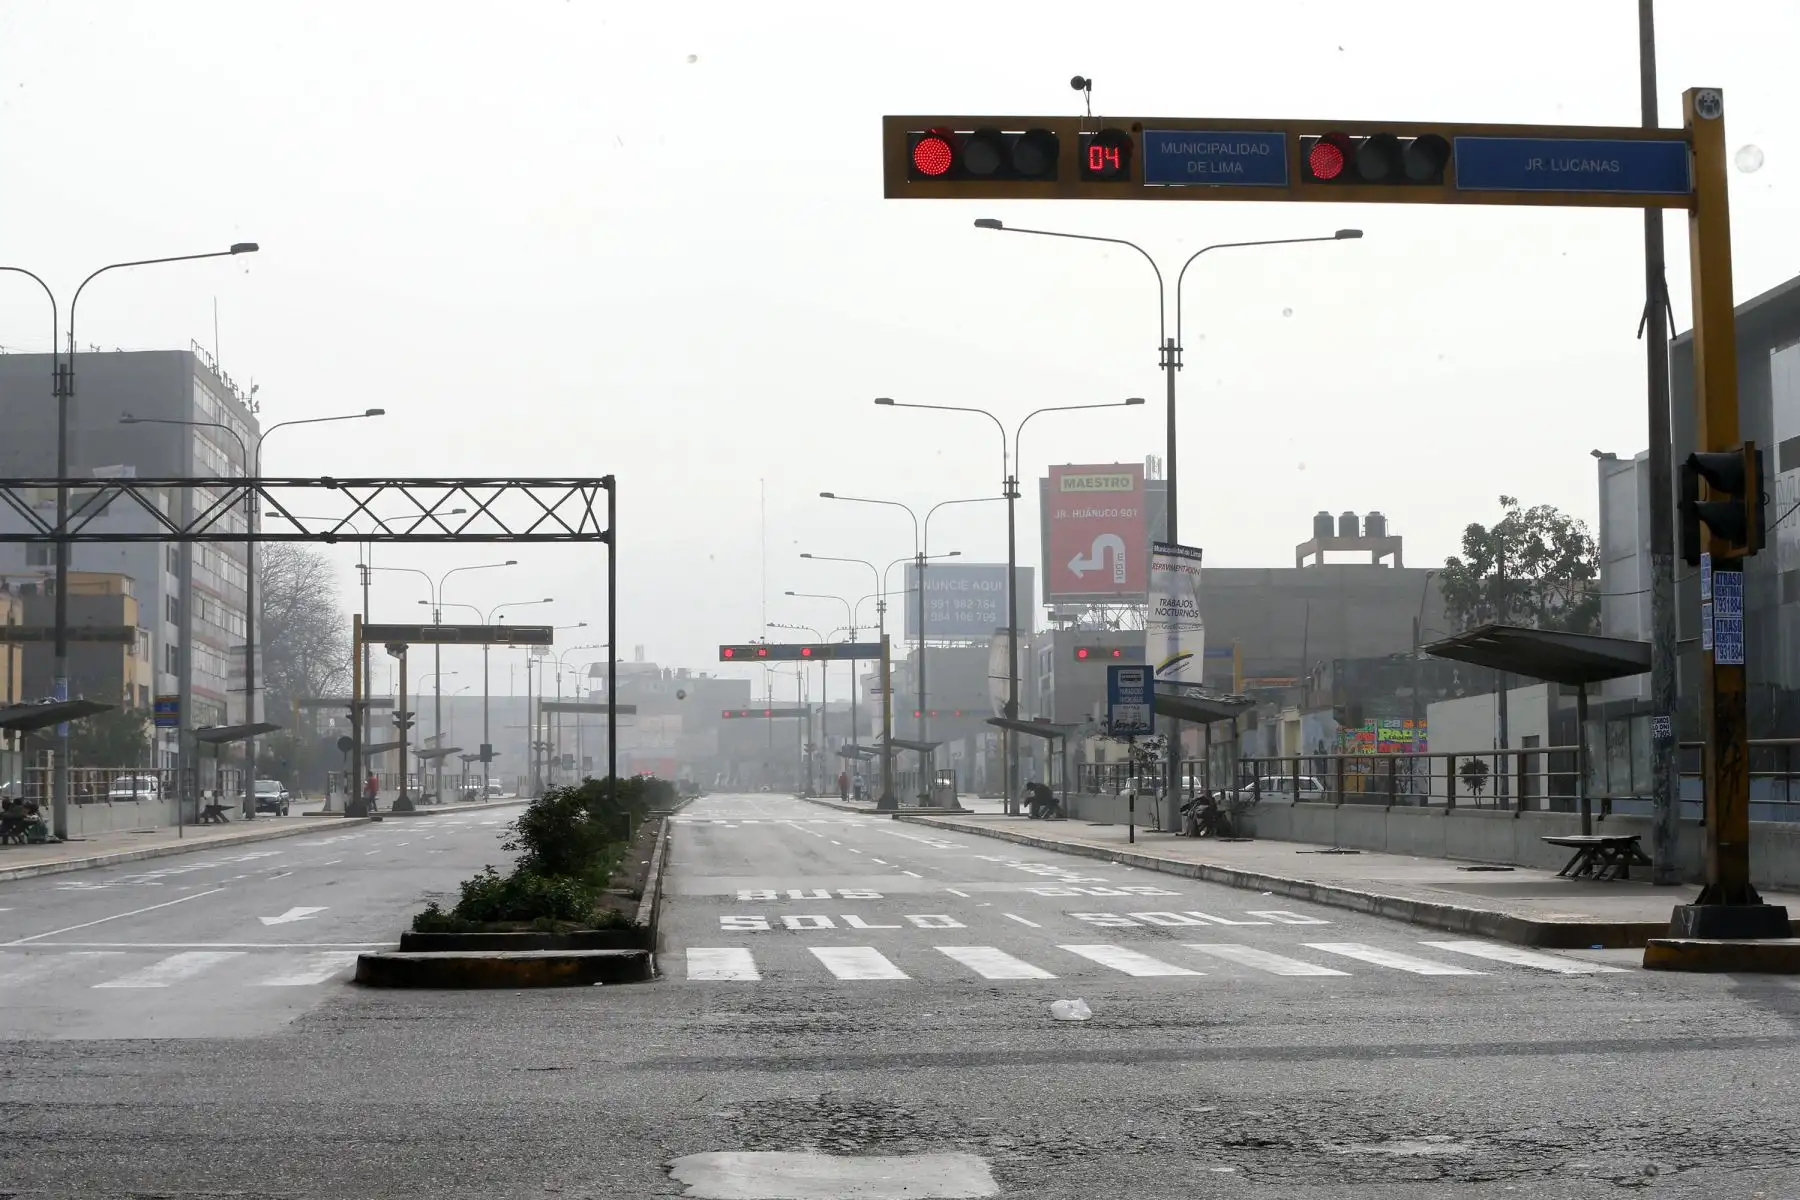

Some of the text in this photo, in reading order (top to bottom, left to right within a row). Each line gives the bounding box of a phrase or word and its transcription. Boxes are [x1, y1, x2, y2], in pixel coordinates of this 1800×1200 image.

[1160, 142, 1270, 156] MUNICIPALIDAD
[1088, 145, 1119, 171] 04
[1187, 161, 1244, 174] DE LIMA
[1524, 158, 1620, 172] JR. LUCANAS
[1064, 477, 1130, 489] MAESTRO
[912, 579, 1002, 591] ANUNCIE AQUI
[1715, 573, 1742, 586] ATRASO
[1159, 598, 1193, 609] TRABAJOS
[1154, 608, 1199, 618] NOCTURNOS
[1716, 619, 1742, 633] ATRASO
[736, 888, 884, 900] BUS
[720, 914, 966, 930] SOLO
[1066, 911, 1334, 927] SOLO
